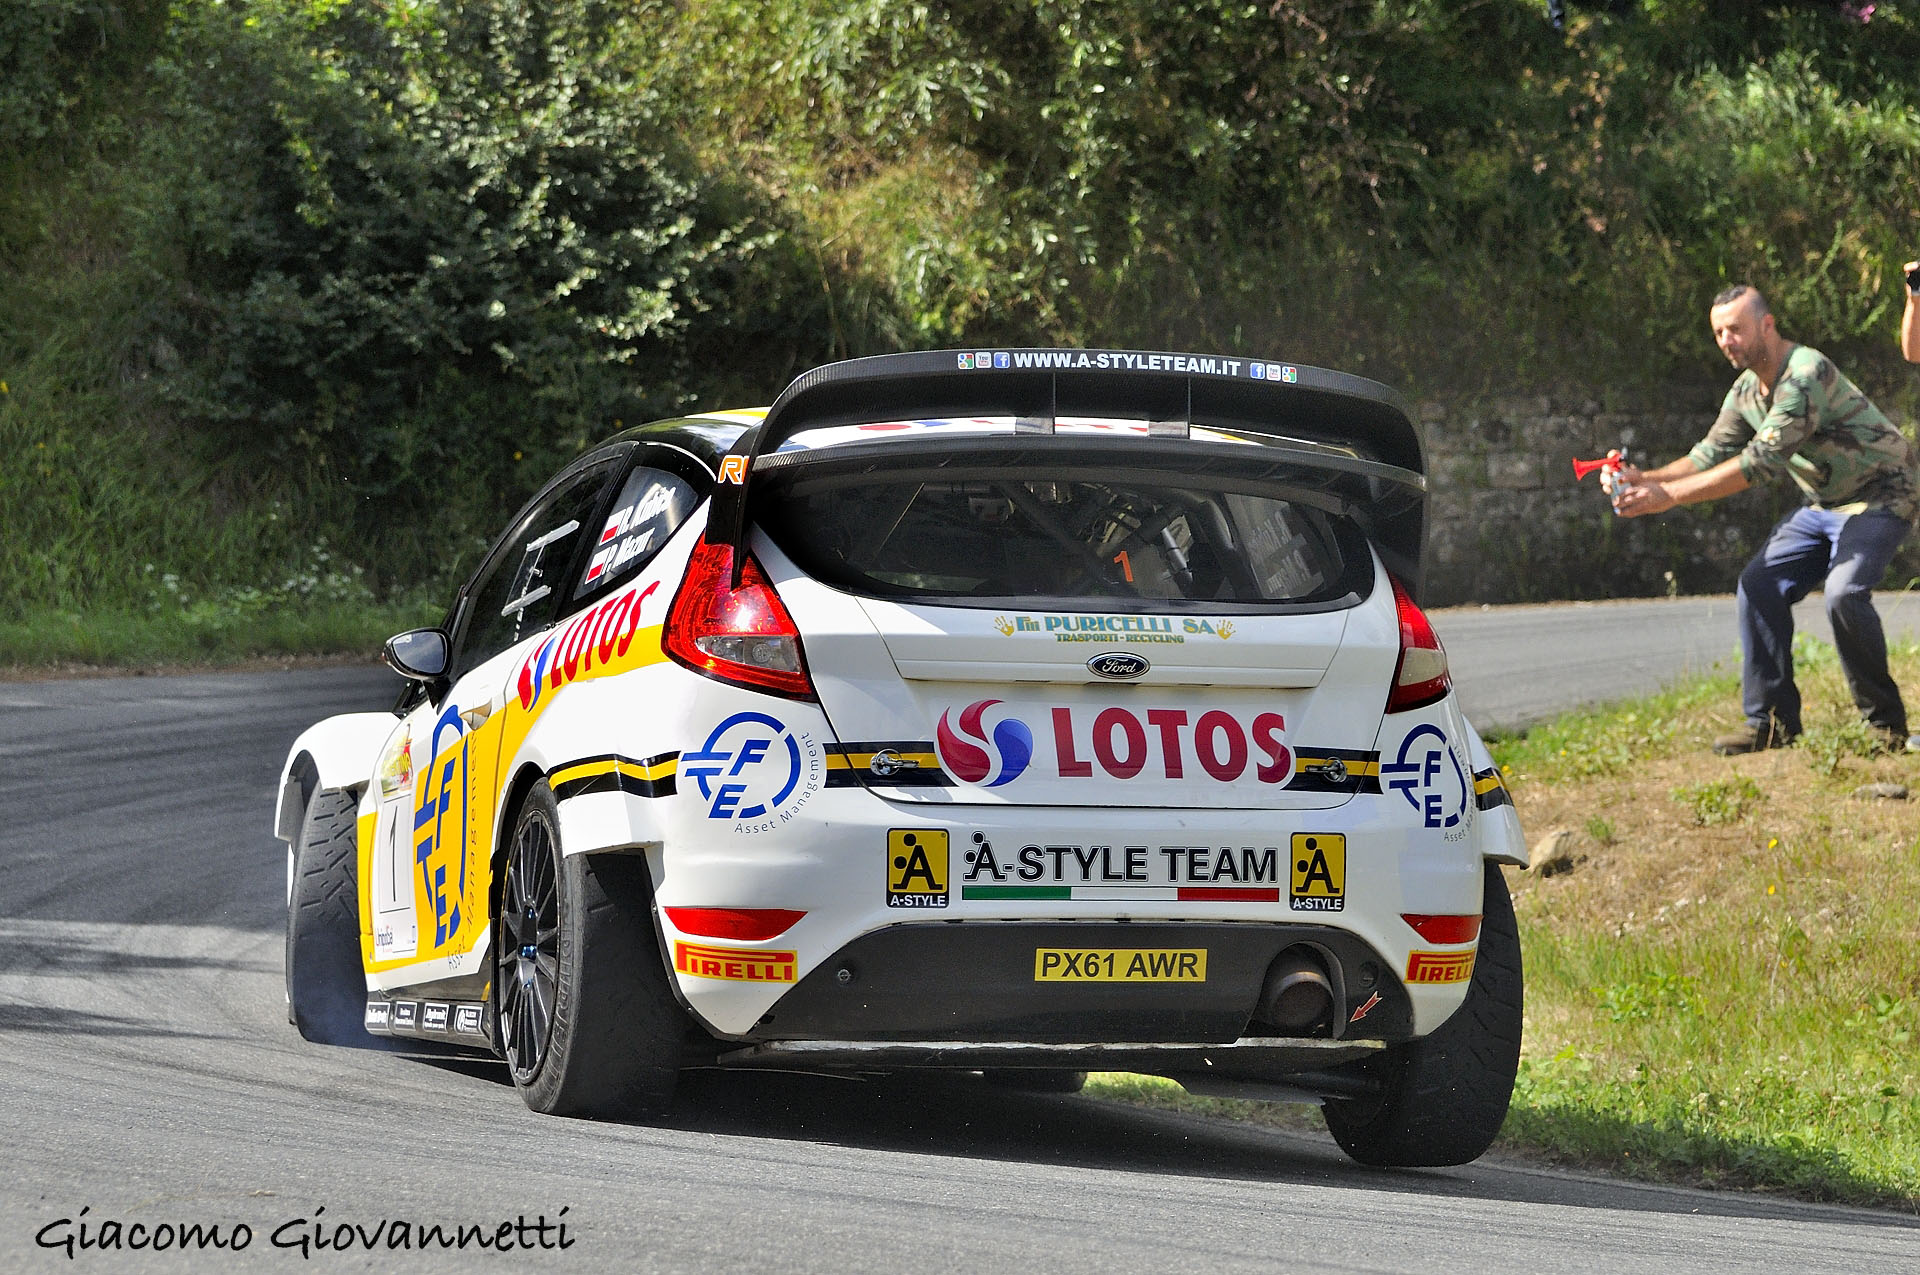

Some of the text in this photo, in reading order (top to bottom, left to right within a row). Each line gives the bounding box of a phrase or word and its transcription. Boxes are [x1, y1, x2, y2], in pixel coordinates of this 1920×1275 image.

[1013, 352, 1241, 377] WWW.A-STYLETEAM.IT
[1113, 550, 1133, 582] 1
[550, 580, 661, 690] LOTOS
[1044, 616, 1172, 633] PURICELLI
[1182, 618, 1216, 635] SA
[1102, 658, 1137, 673] Ford
[1051, 706, 1291, 784] LOTOS
[735, 731, 819, 834] Asset Management
[390, 806, 398, 902] 1
[963, 840, 1279, 884] A-STYLE TEAM
[890, 895, 946, 908] A-STYLE
[1293, 898, 1342, 910] A-STYLE
[676, 943, 795, 981] PIRELLI
[1041, 952, 1199, 978] PX61 AWR
[1407, 951, 1476, 982] PIRELLI
